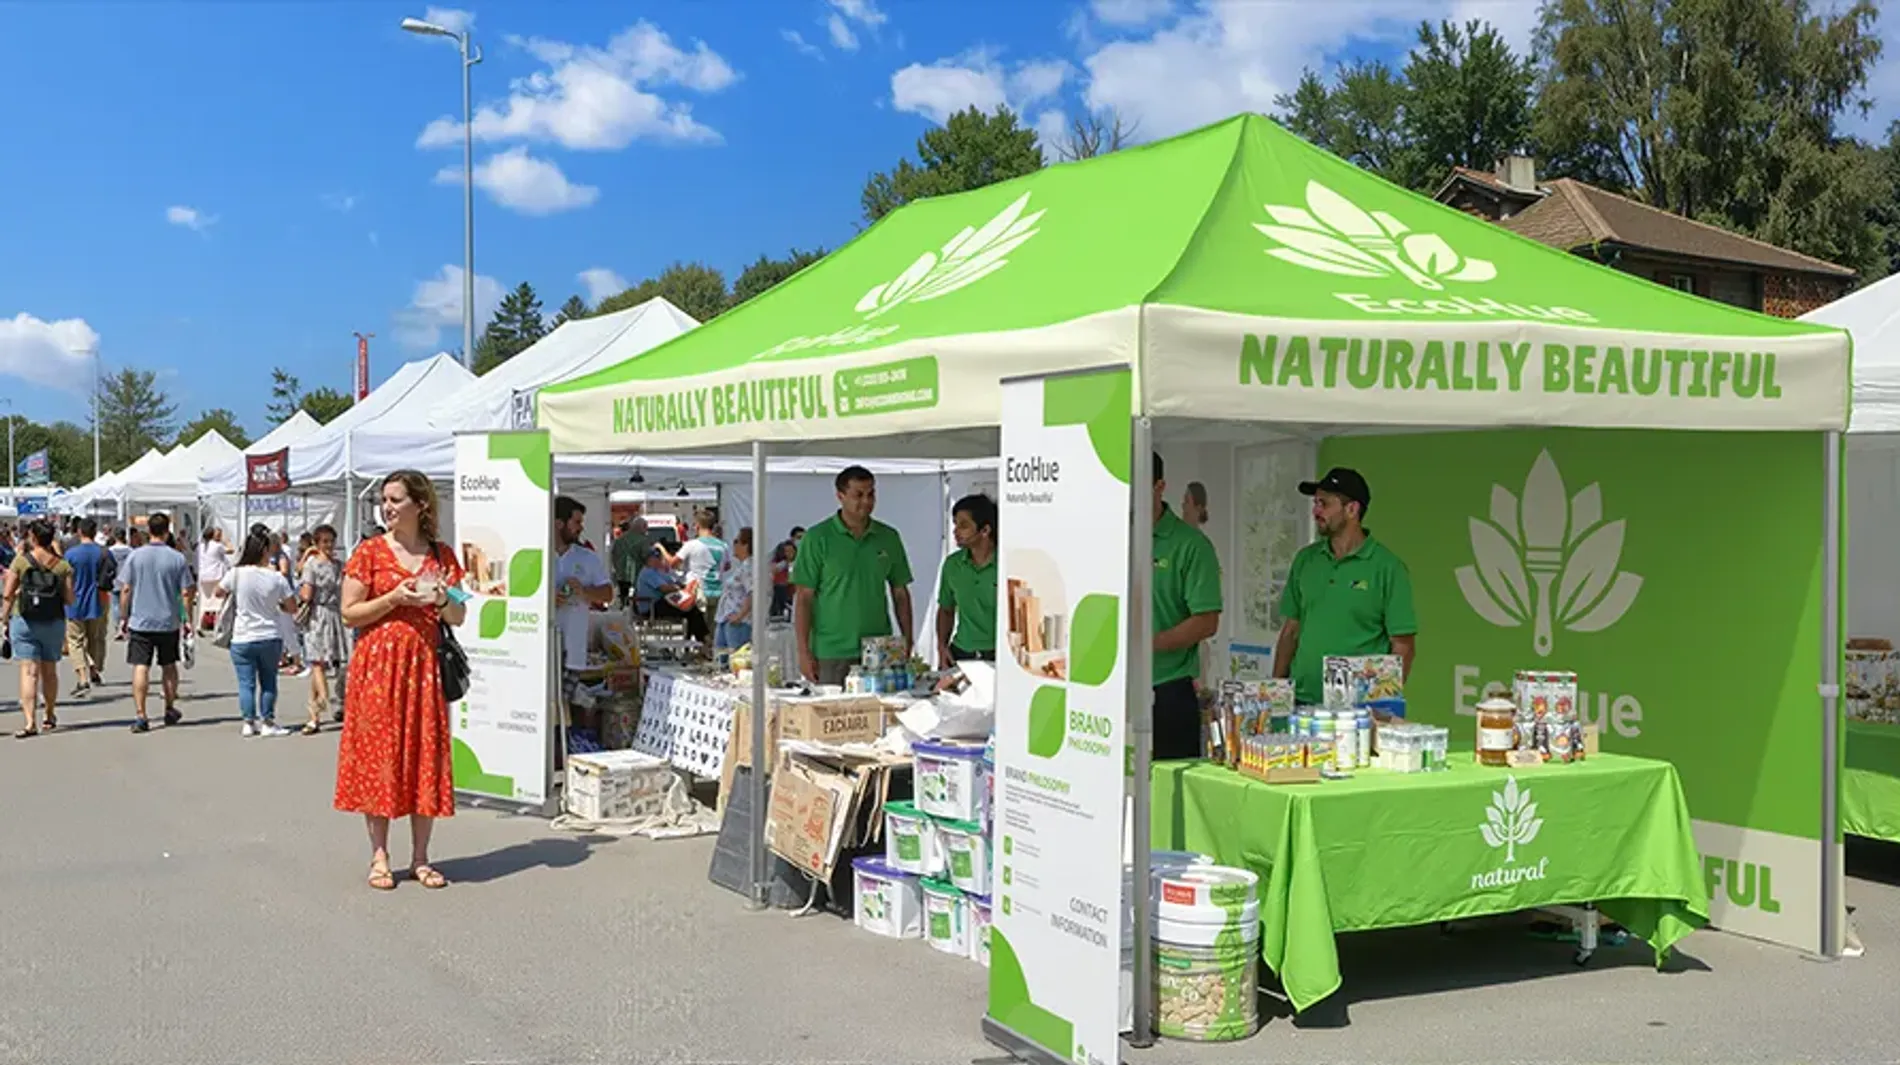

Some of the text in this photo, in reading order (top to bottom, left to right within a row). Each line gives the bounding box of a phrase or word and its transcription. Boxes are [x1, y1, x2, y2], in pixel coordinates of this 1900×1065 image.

[1332, 291, 1600, 323] EcoHue
[1239, 333, 1782, 399] NATURALLY BEAUTIFUL
[612, 387, 710, 434] NATURALLY
[713, 375, 828, 426] BEAUTIFUL
[460, 475, 501, 491] EcoHue
[1006, 456, 1060, 484] EcoHue
[1454, 665, 1643, 738] Eue
[1069, 710, 1112, 738] BRAND
[1471, 856, 1549, 890] natural
[1697, 853, 1781, 914] FUL
[1069, 896, 1108, 924] CONTACT
[1050, 913, 1109, 949] INFORMATION
